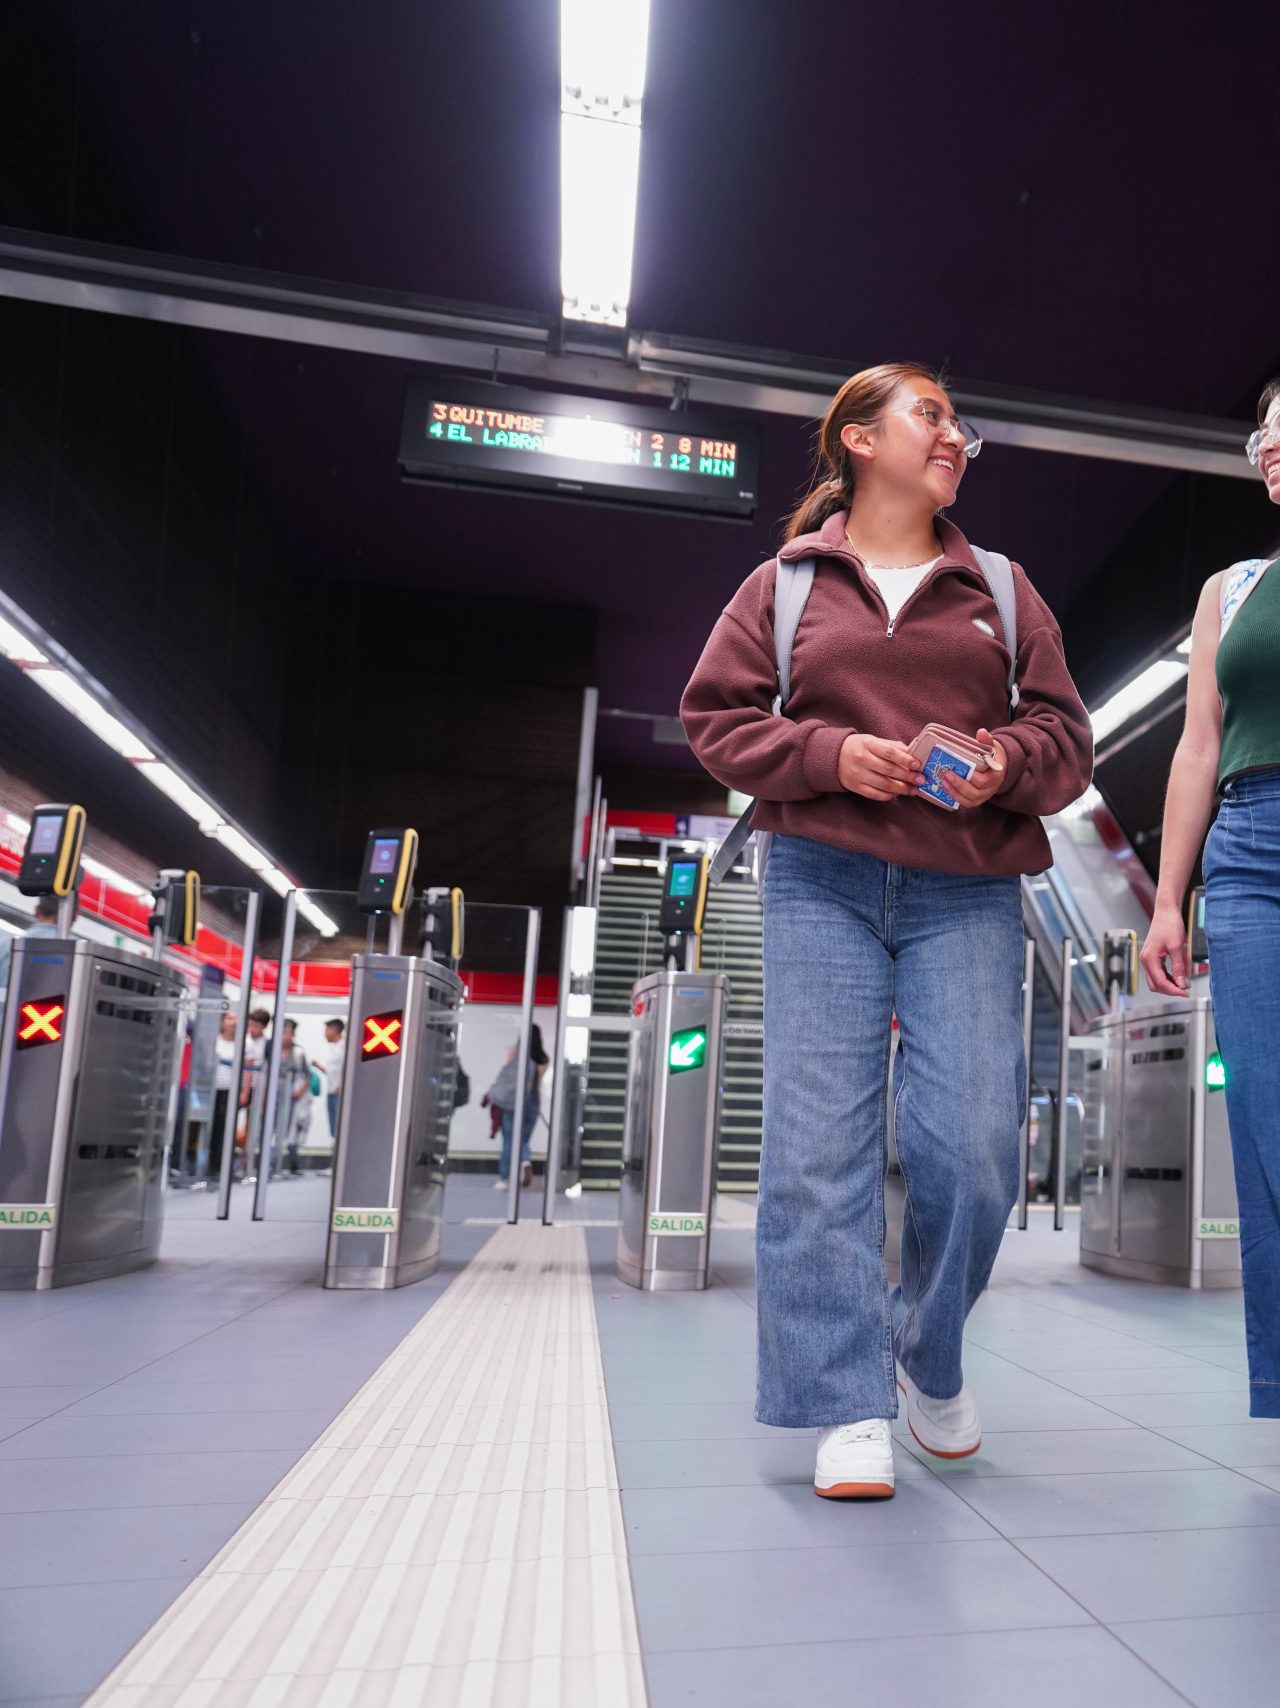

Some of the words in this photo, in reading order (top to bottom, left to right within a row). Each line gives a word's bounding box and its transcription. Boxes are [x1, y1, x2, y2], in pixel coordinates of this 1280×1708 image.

[449, 407, 545, 433] QUITUMBE
[650, 433, 664, 450] 2
[678, 437, 692, 454] 8
[700, 440, 736, 460] MIN
[430, 421, 443, 438] 4
[447, 423, 472, 442] EL
[653, 451, 662, 468] 1
[669, 453, 691, 471] 12
[699, 457, 736, 477] MIN
[0, 1211, 51, 1224] ALIDA
[335, 1214, 394, 1227] SALIDA
[650, 1219, 704, 1231] SALIDA
[1200, 1222, 1239, 1234] SALID
